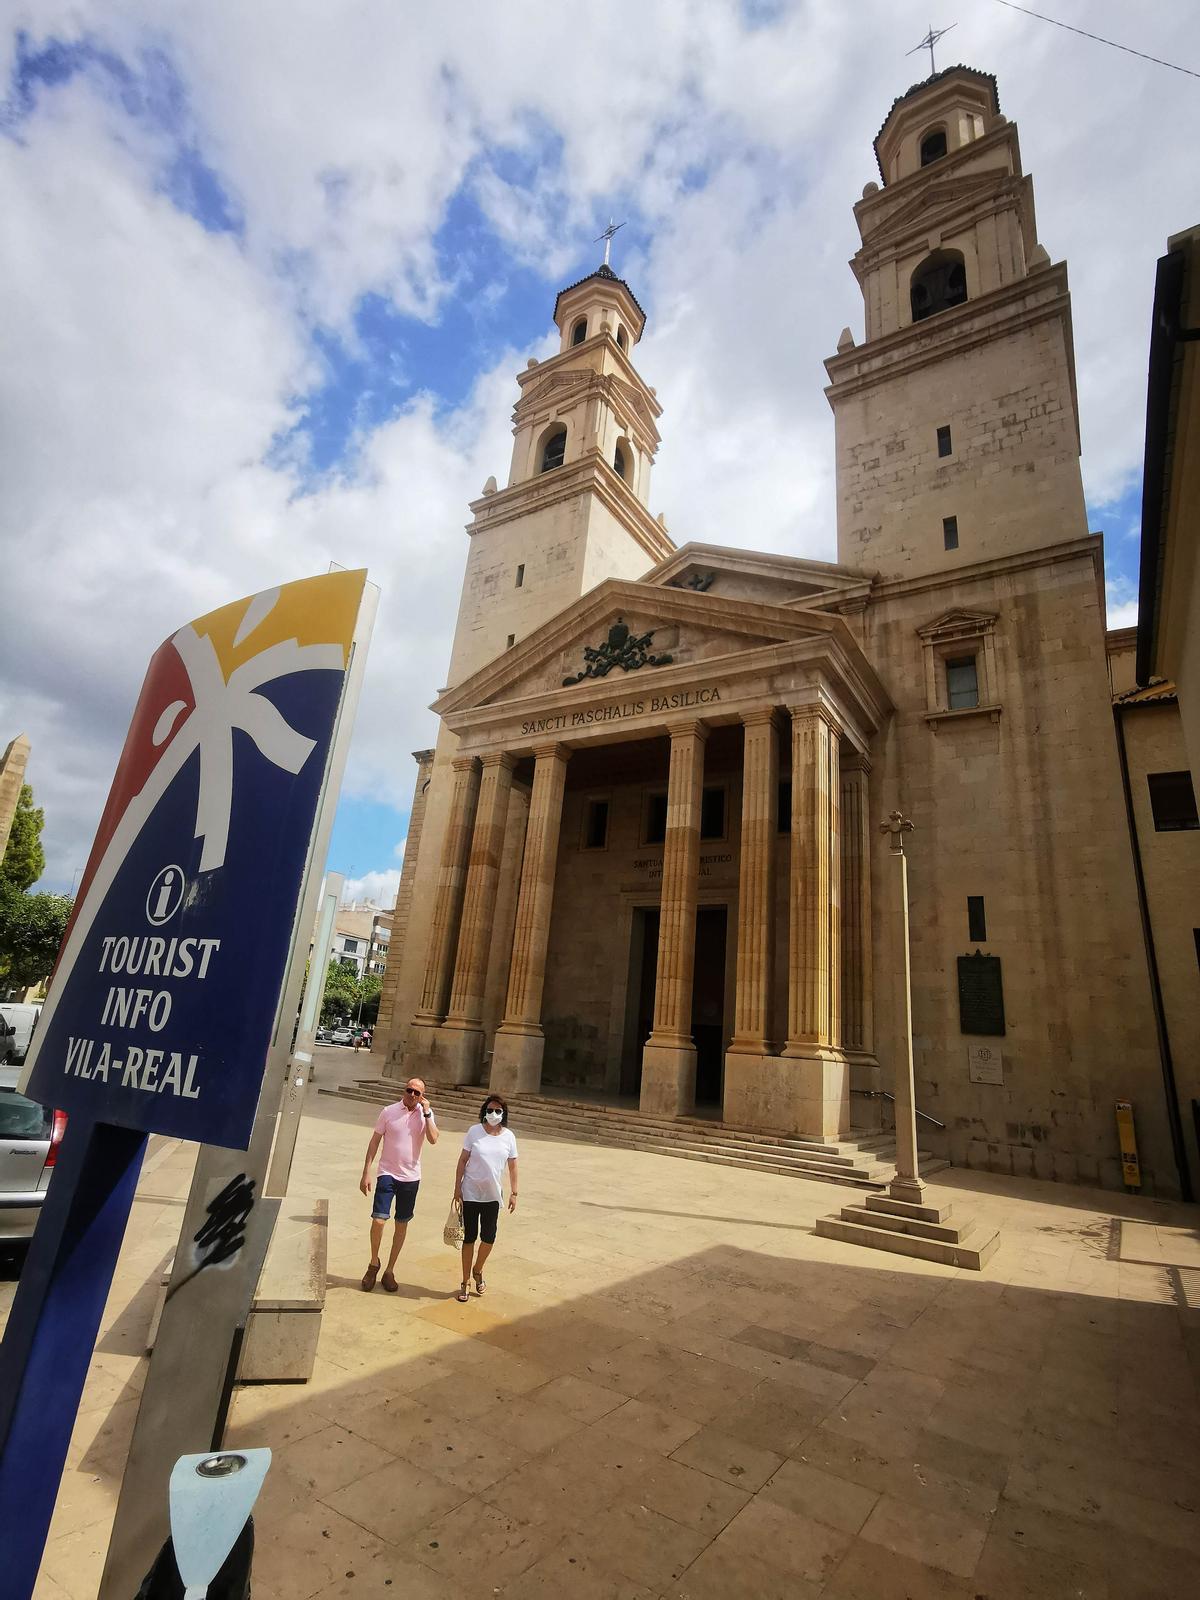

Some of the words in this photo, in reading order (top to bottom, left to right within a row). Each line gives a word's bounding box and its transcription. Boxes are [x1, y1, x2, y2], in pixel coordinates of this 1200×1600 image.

[521, 717, 566, 734] SANCTI
[571, 702, 645, 725] PASCHALIS
[650, 687, 720, 711] BASILICA
[633, 858, 664, 868] SANTUA
[99, 936, 221, 979] TOURIST
[101, 987, 172, 1032] INFO
[64, 1037, 201, 1099] VILA-REAL
